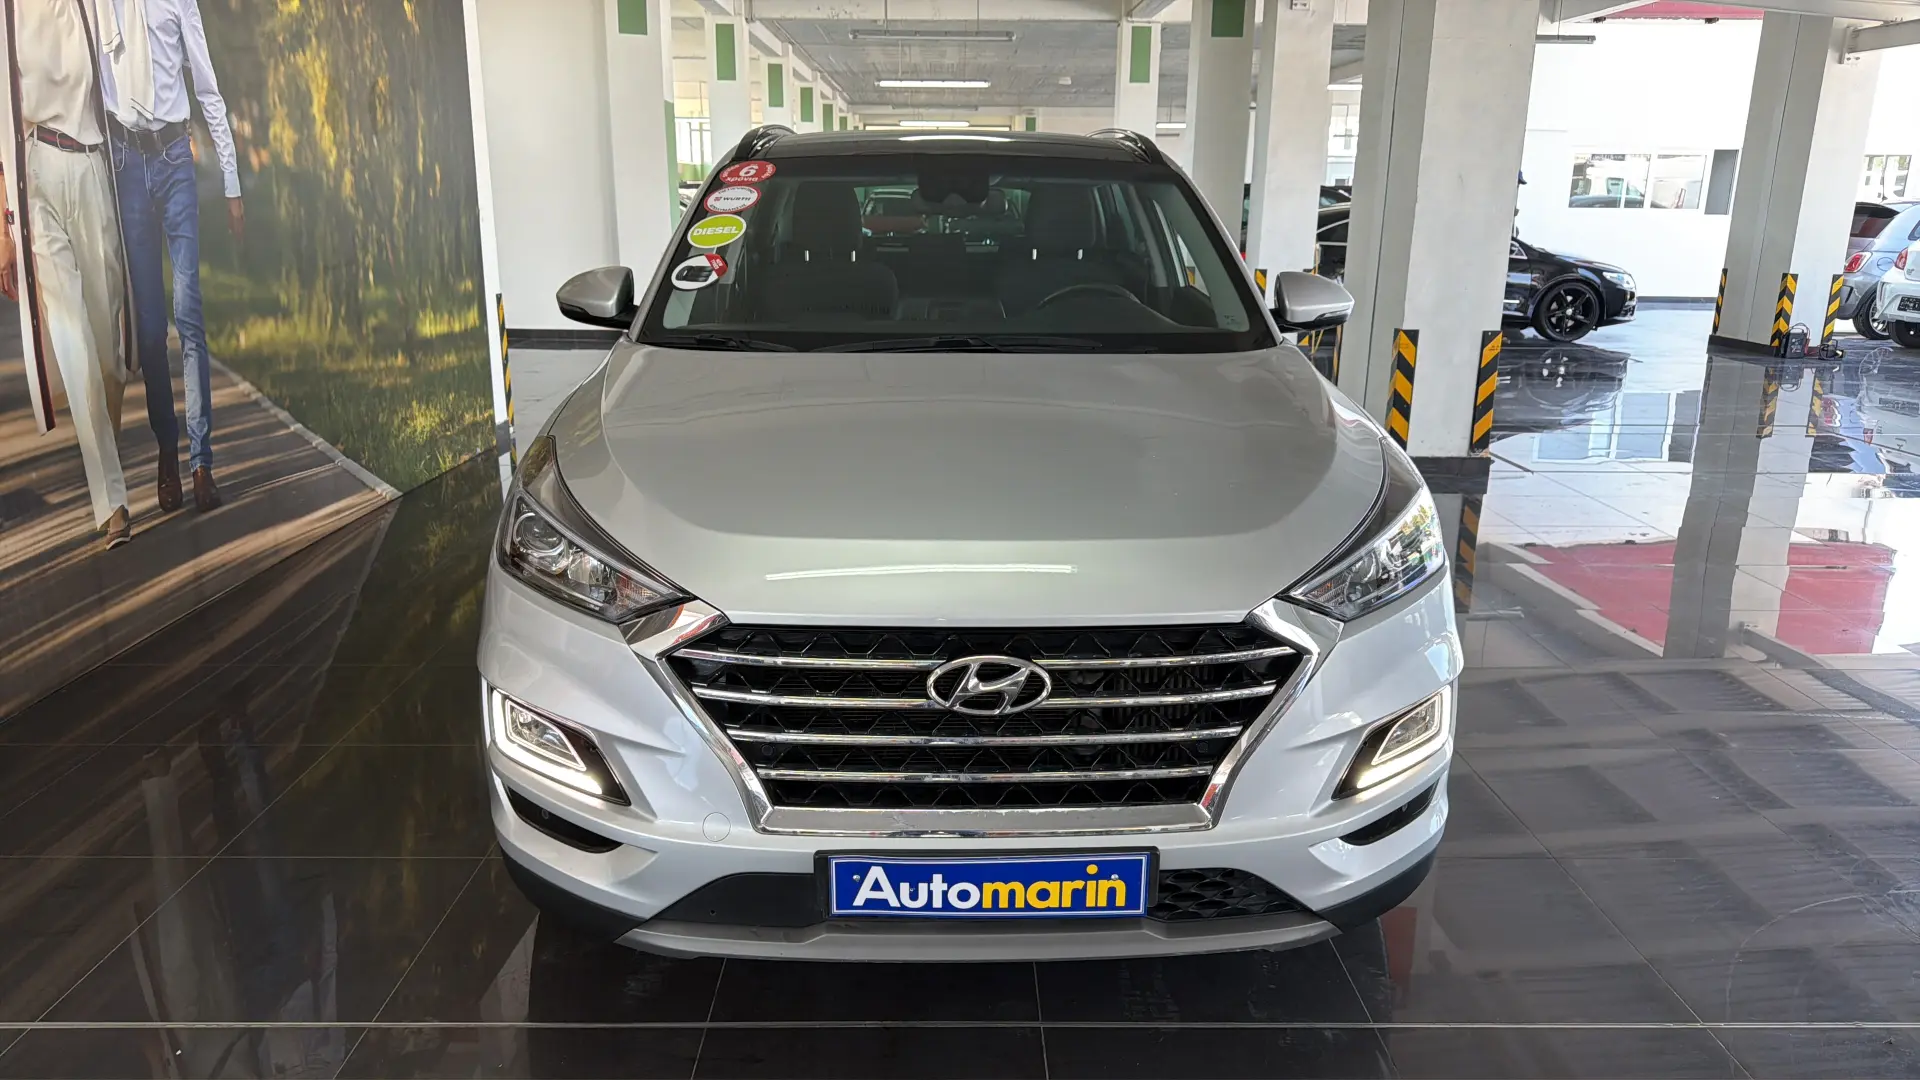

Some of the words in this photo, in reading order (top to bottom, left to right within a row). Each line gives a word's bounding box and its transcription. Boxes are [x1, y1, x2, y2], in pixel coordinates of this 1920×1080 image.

[739, 165, 759, 177] 6
[693, 226, 739, 236] DIESEL
[852, 864, 1126, 909] Automarin
